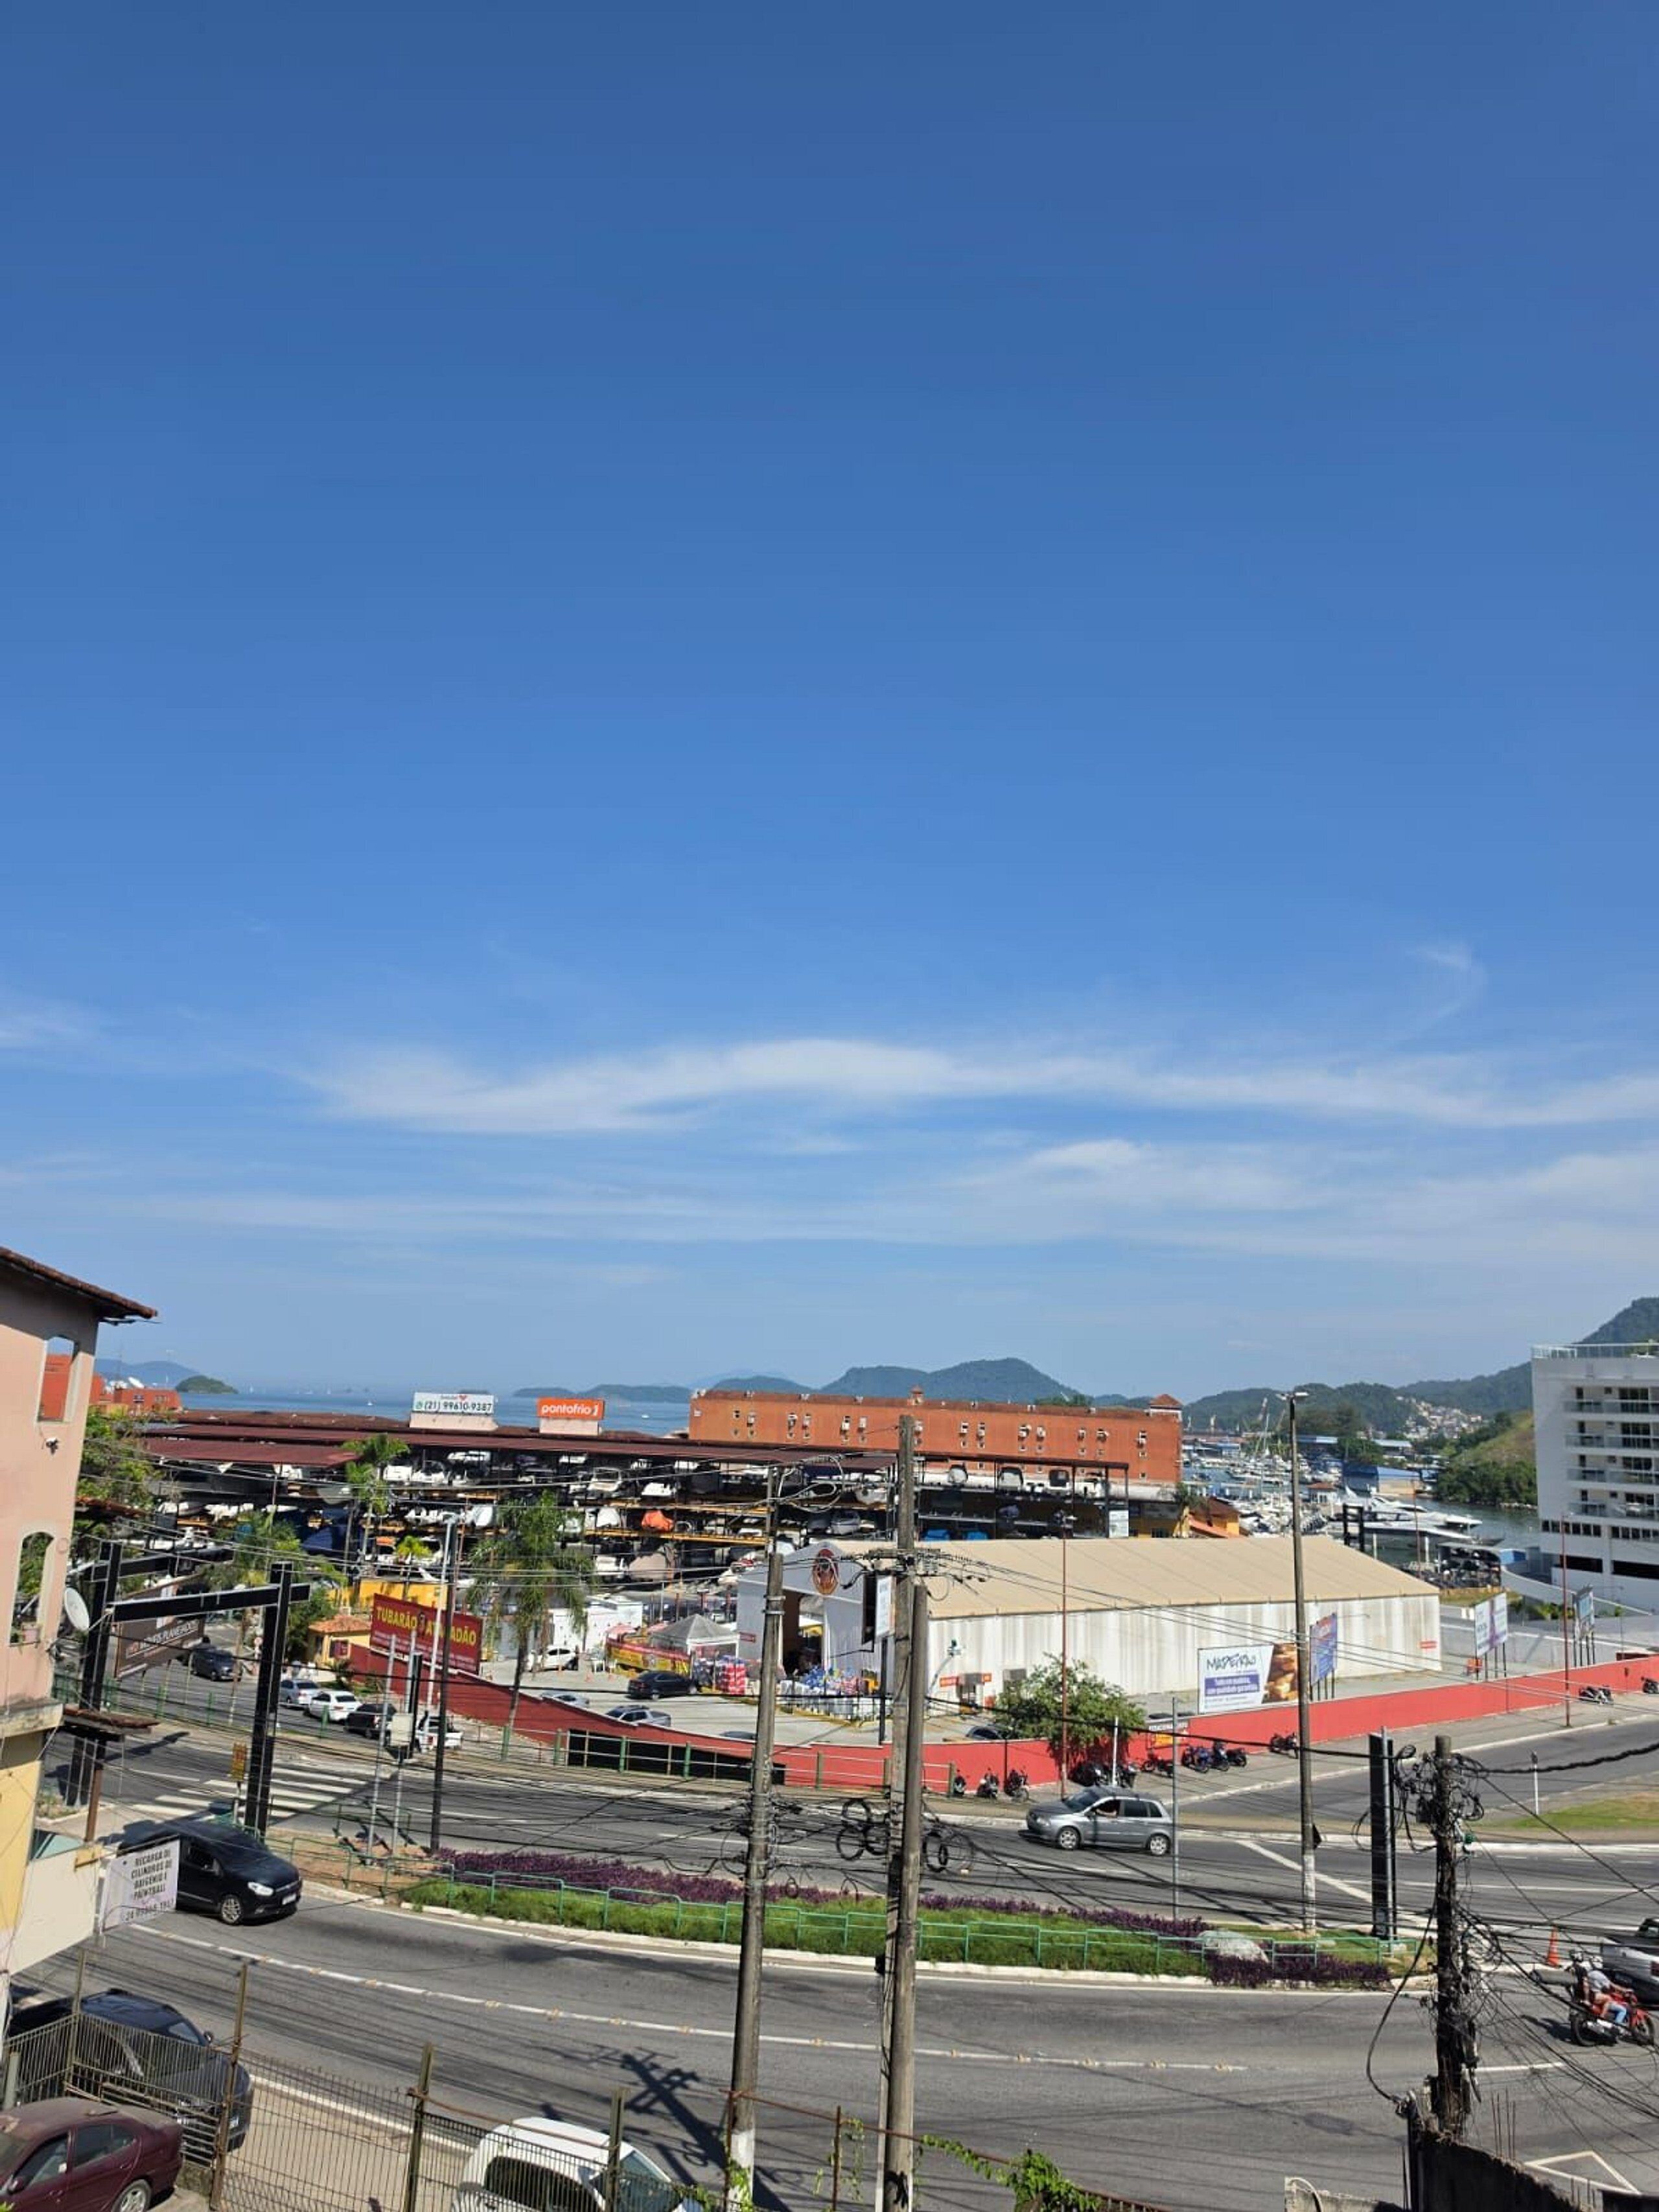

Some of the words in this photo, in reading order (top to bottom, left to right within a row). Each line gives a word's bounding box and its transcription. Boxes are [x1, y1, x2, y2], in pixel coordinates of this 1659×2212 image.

[424, 1401, 441, 1411] (21)
[542, 1404, 592, 1415] pontofrio
[377, 1607, 417, 1629] TUBARÃO
[425, 1621, 476, 1647] ATAADÃO
[135, 1851, 162, 1867] RECARGA
[132, 1861, 163, 1880] CILINDROS
